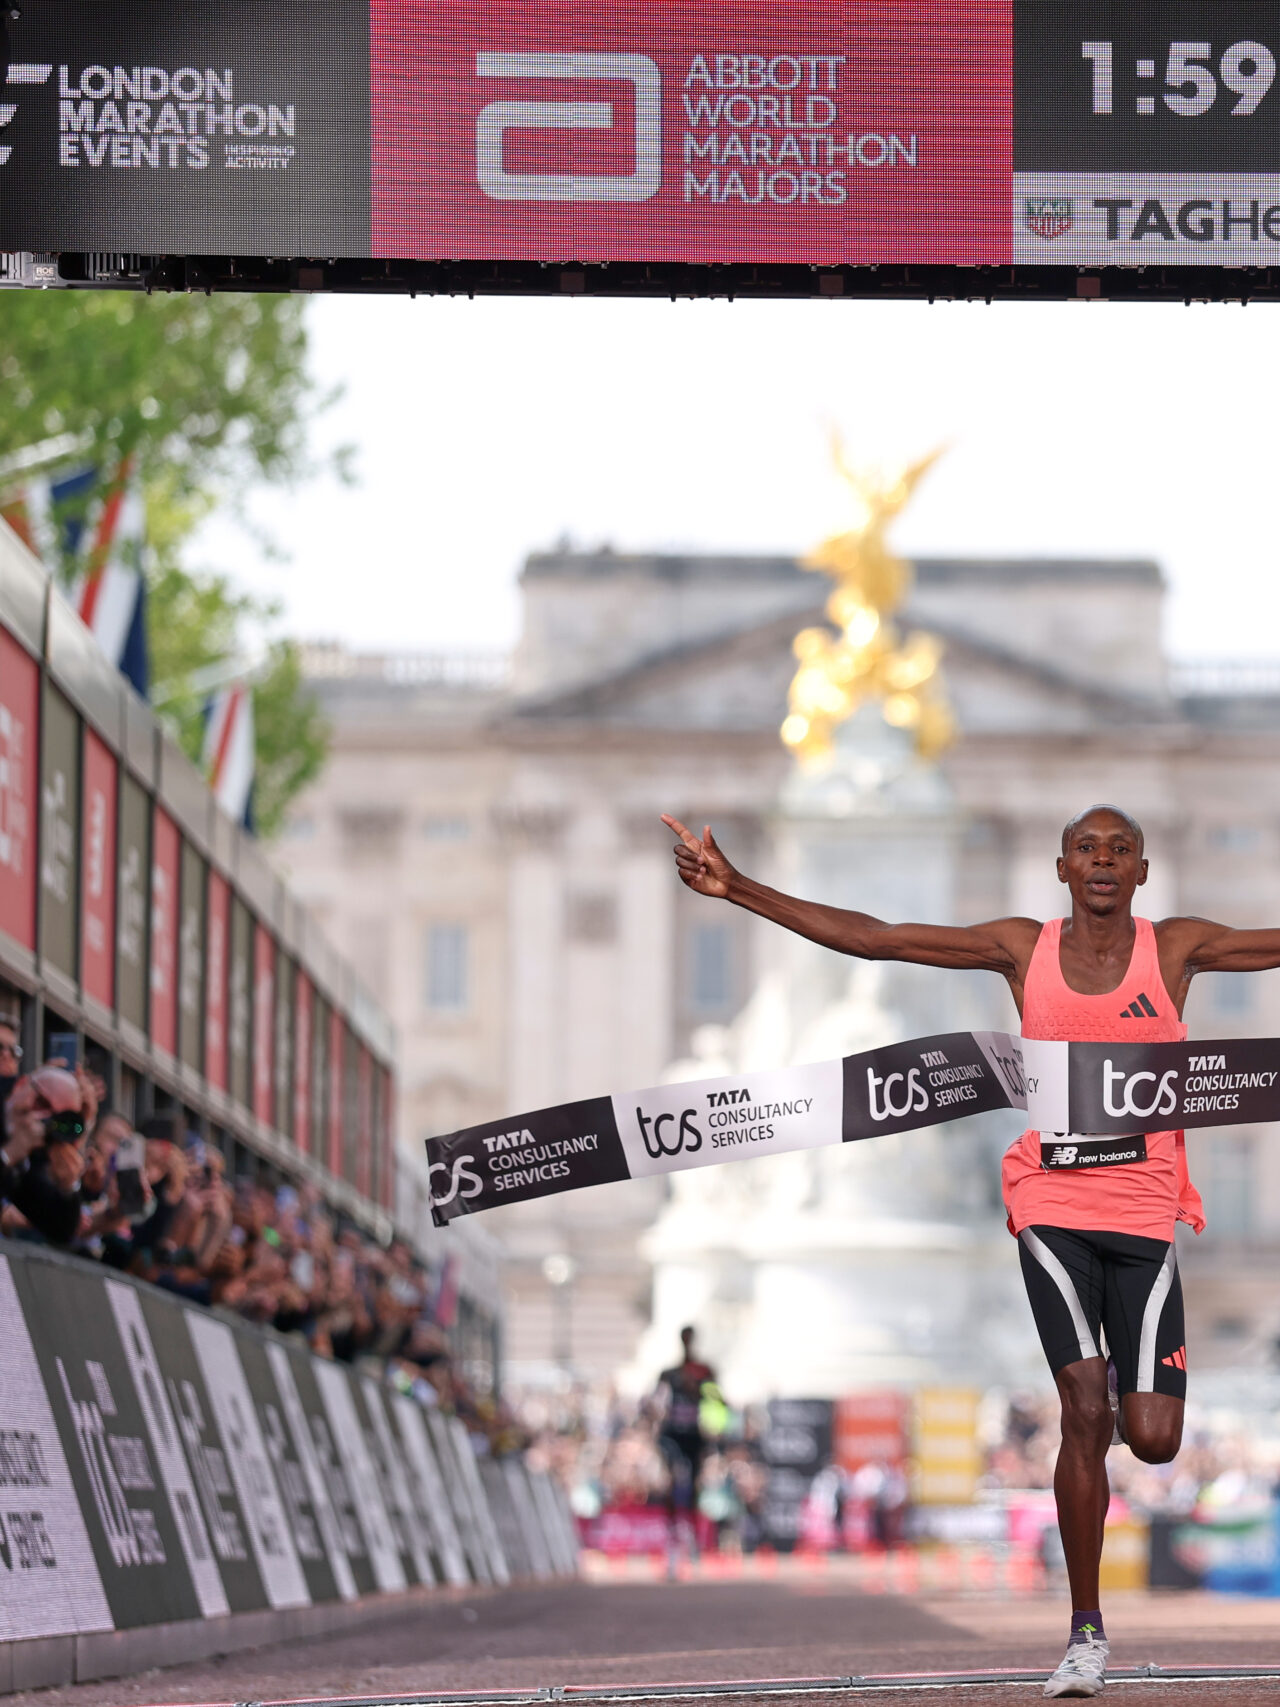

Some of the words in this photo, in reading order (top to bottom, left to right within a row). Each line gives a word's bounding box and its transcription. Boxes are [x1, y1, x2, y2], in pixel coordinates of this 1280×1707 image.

[58, 64, 233, 101] LONDON
[684, 54, 846, 90] ABBOTT
[58, 100, 295, 136] MARATHON
[683, 94, 838, 127] WORLD
[59, 133, 210, 168] EVENTS
[683, 132, 917, 166] MARATHON
[683, 170, 848, 204] MAJORS
[920, 1050, 950, 1068] TATA
[1187, 1055, 1226, 1071] TATA
[928, 1064, 985, 1087] CONSULTANCY
[1102, 1058, 1178, 1117] tcs
[1184, 1071, 1278, 1092] CONSULTANCY
[706, 1088, 752, 1108] TATA
[867, 1067, 929, 1121] tcs
[934, 1084, 978, 1107] SERVICES
[1182, 1094, 1240, 1114] SERVICES
[708, 1098, 813, 1128] CONSULTANCY
[482, 1128, 537, 1153] TATA
[636, 1106, 703, 1159] tcs
[711, 1124, 774, 1148] SERVICES
[488, 1134, 598, 1171] CONSULTANCY
[1079, 1155, 1098, 1164] new
[1099, 1150, 1137, 1162] balance
[493, 1161, 571, 1191] SERVICES
